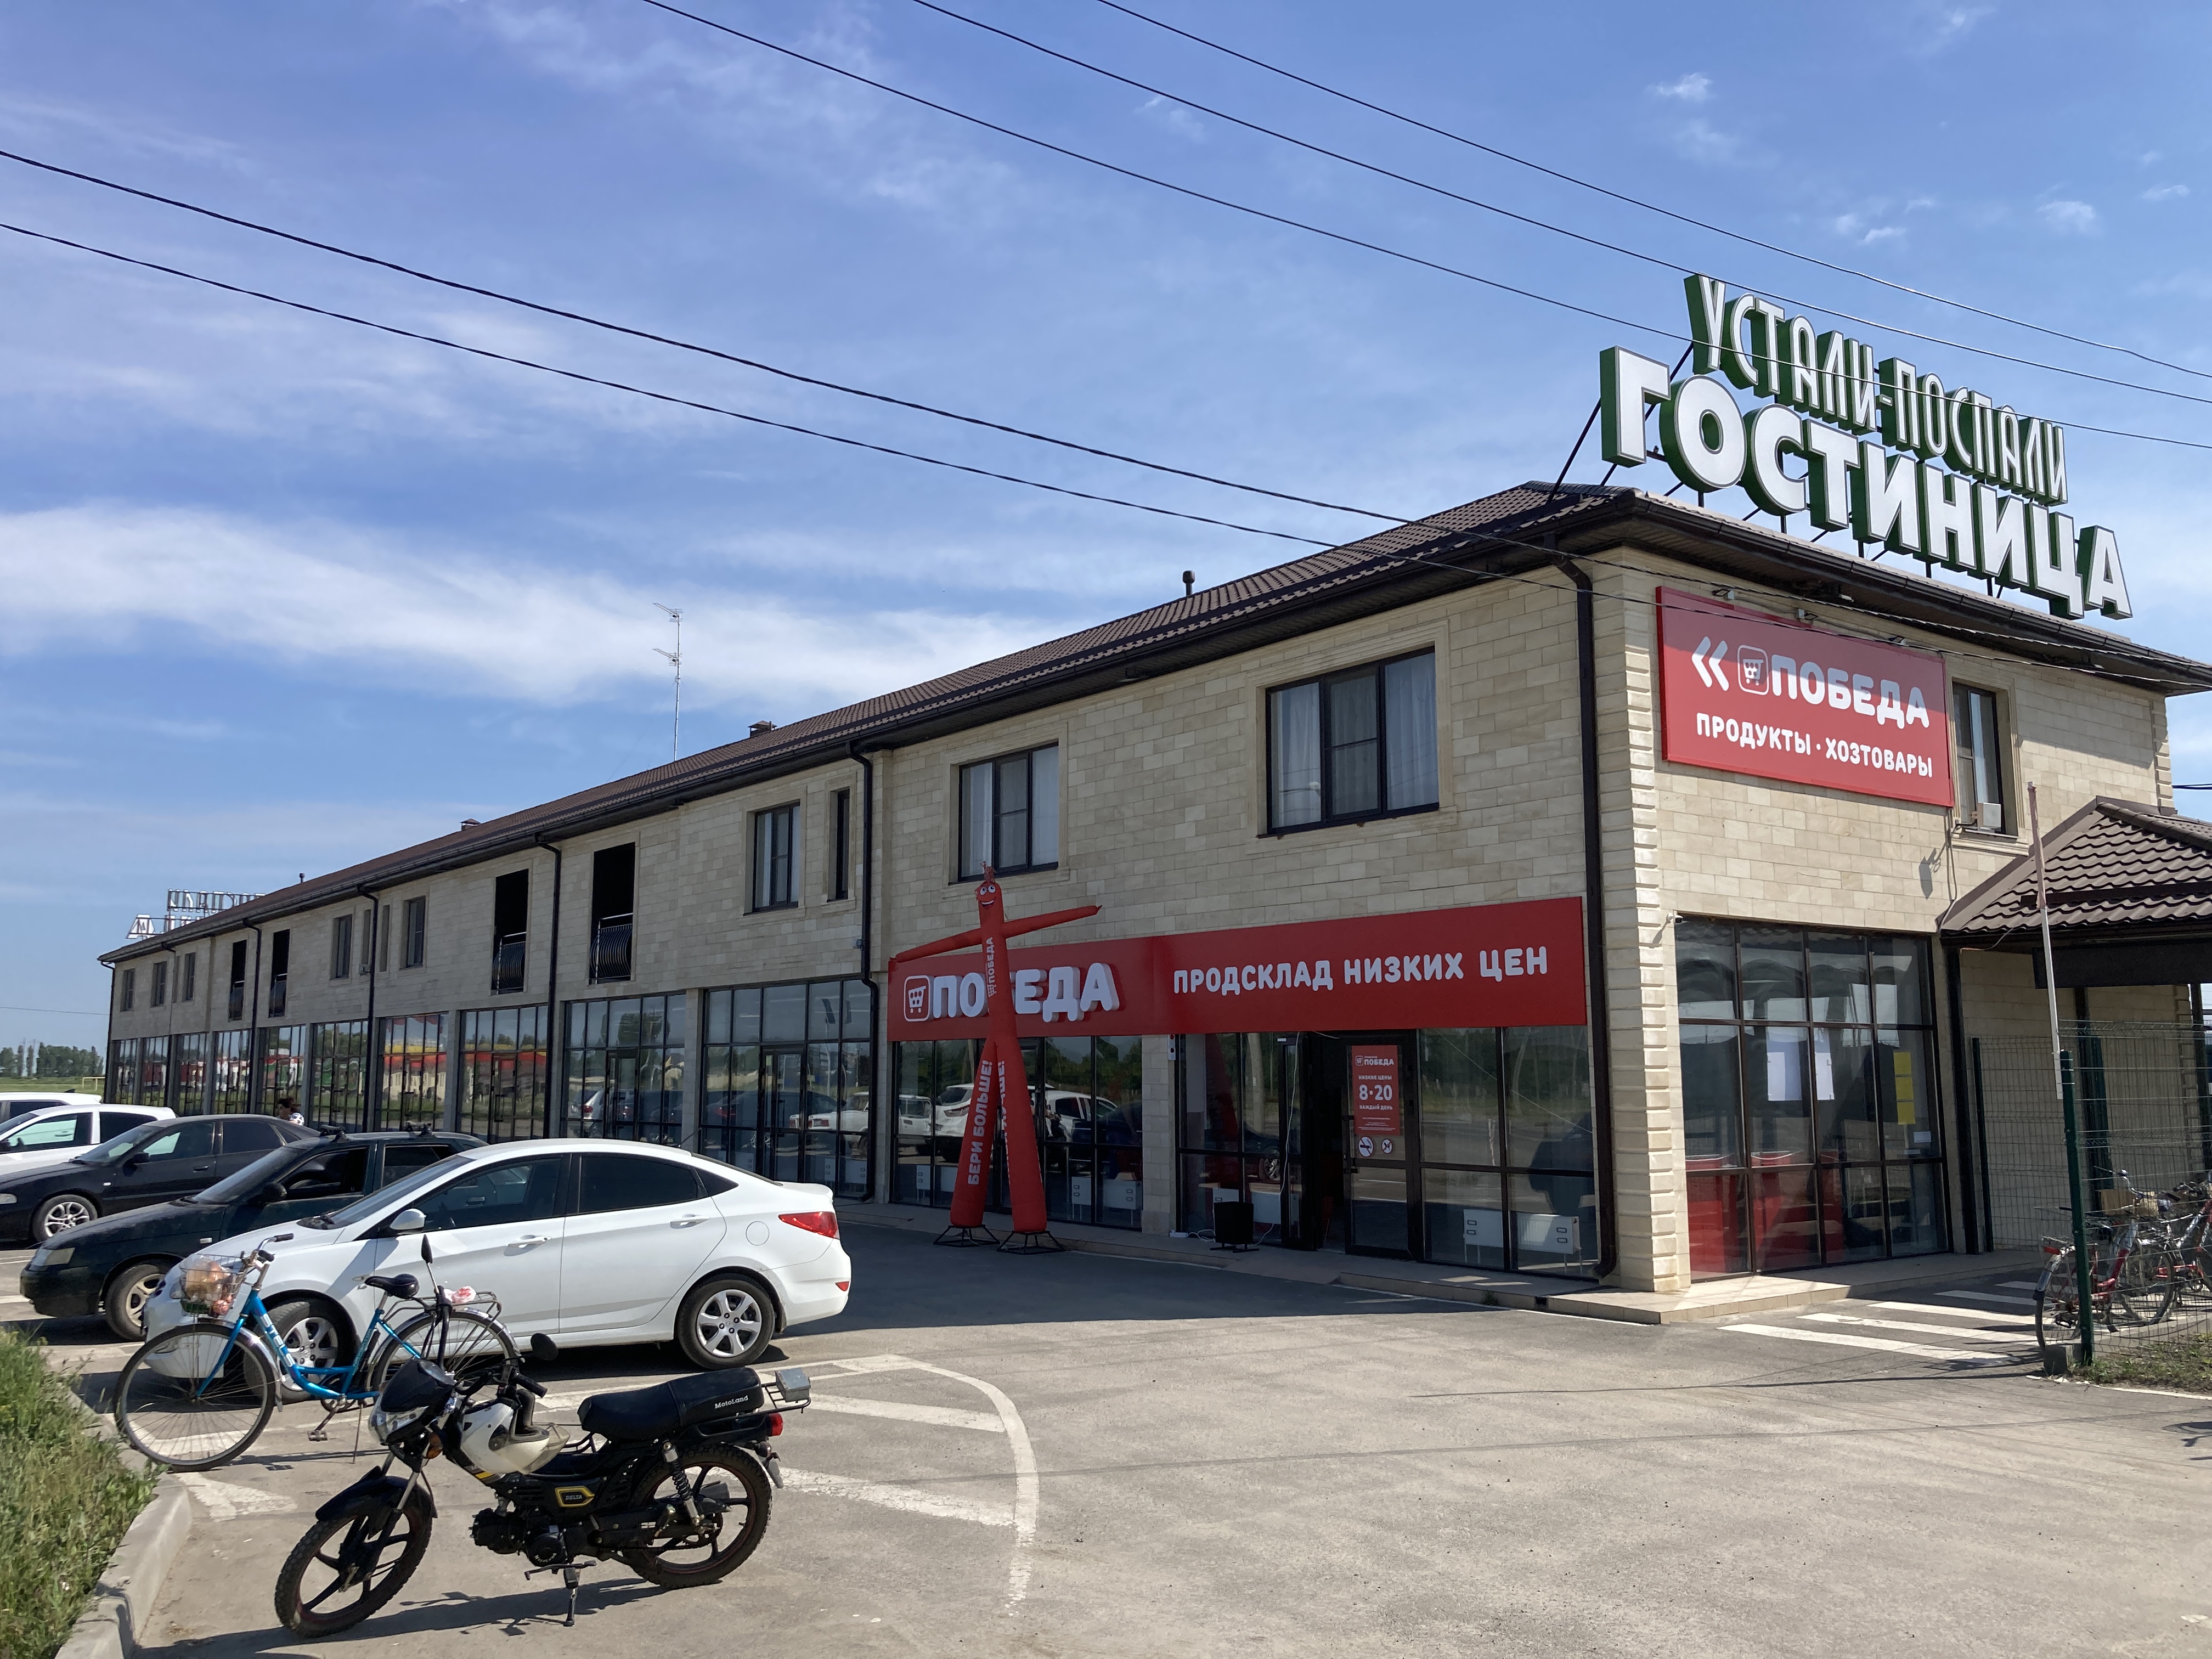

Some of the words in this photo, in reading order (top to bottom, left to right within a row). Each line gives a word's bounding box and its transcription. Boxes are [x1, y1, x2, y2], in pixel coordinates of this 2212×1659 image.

[1684, 273, 2068, 506] УСТАЛИ-ПОСПАЛИ
[1599, 346, 2133, 619] ГОСТИНИЦА
[1770, 653, 1930, 729] ПОБЕДА
[1696, 712, 1812, 756] ПРОДУКТЫ
[1825, 737, 1933, 778] ХОЗТОВАРЫ
[986, 936, 996, 984] ПОБЕДА
[1173, 960, 1334, 997] ПРОДСКЛАД
[1344, 952, 1465, 985] НИЗКИХ
[1479, 946, 1548, 983] ЦЕН
[932, 962, 1120, 1023] ПОЕДА
[973, 1059, 994, 1138] БОЛЬШЕ!
[967, 1141, 984, 1186] БЕРИ
[259, 1313, 296, 1368] STELS
